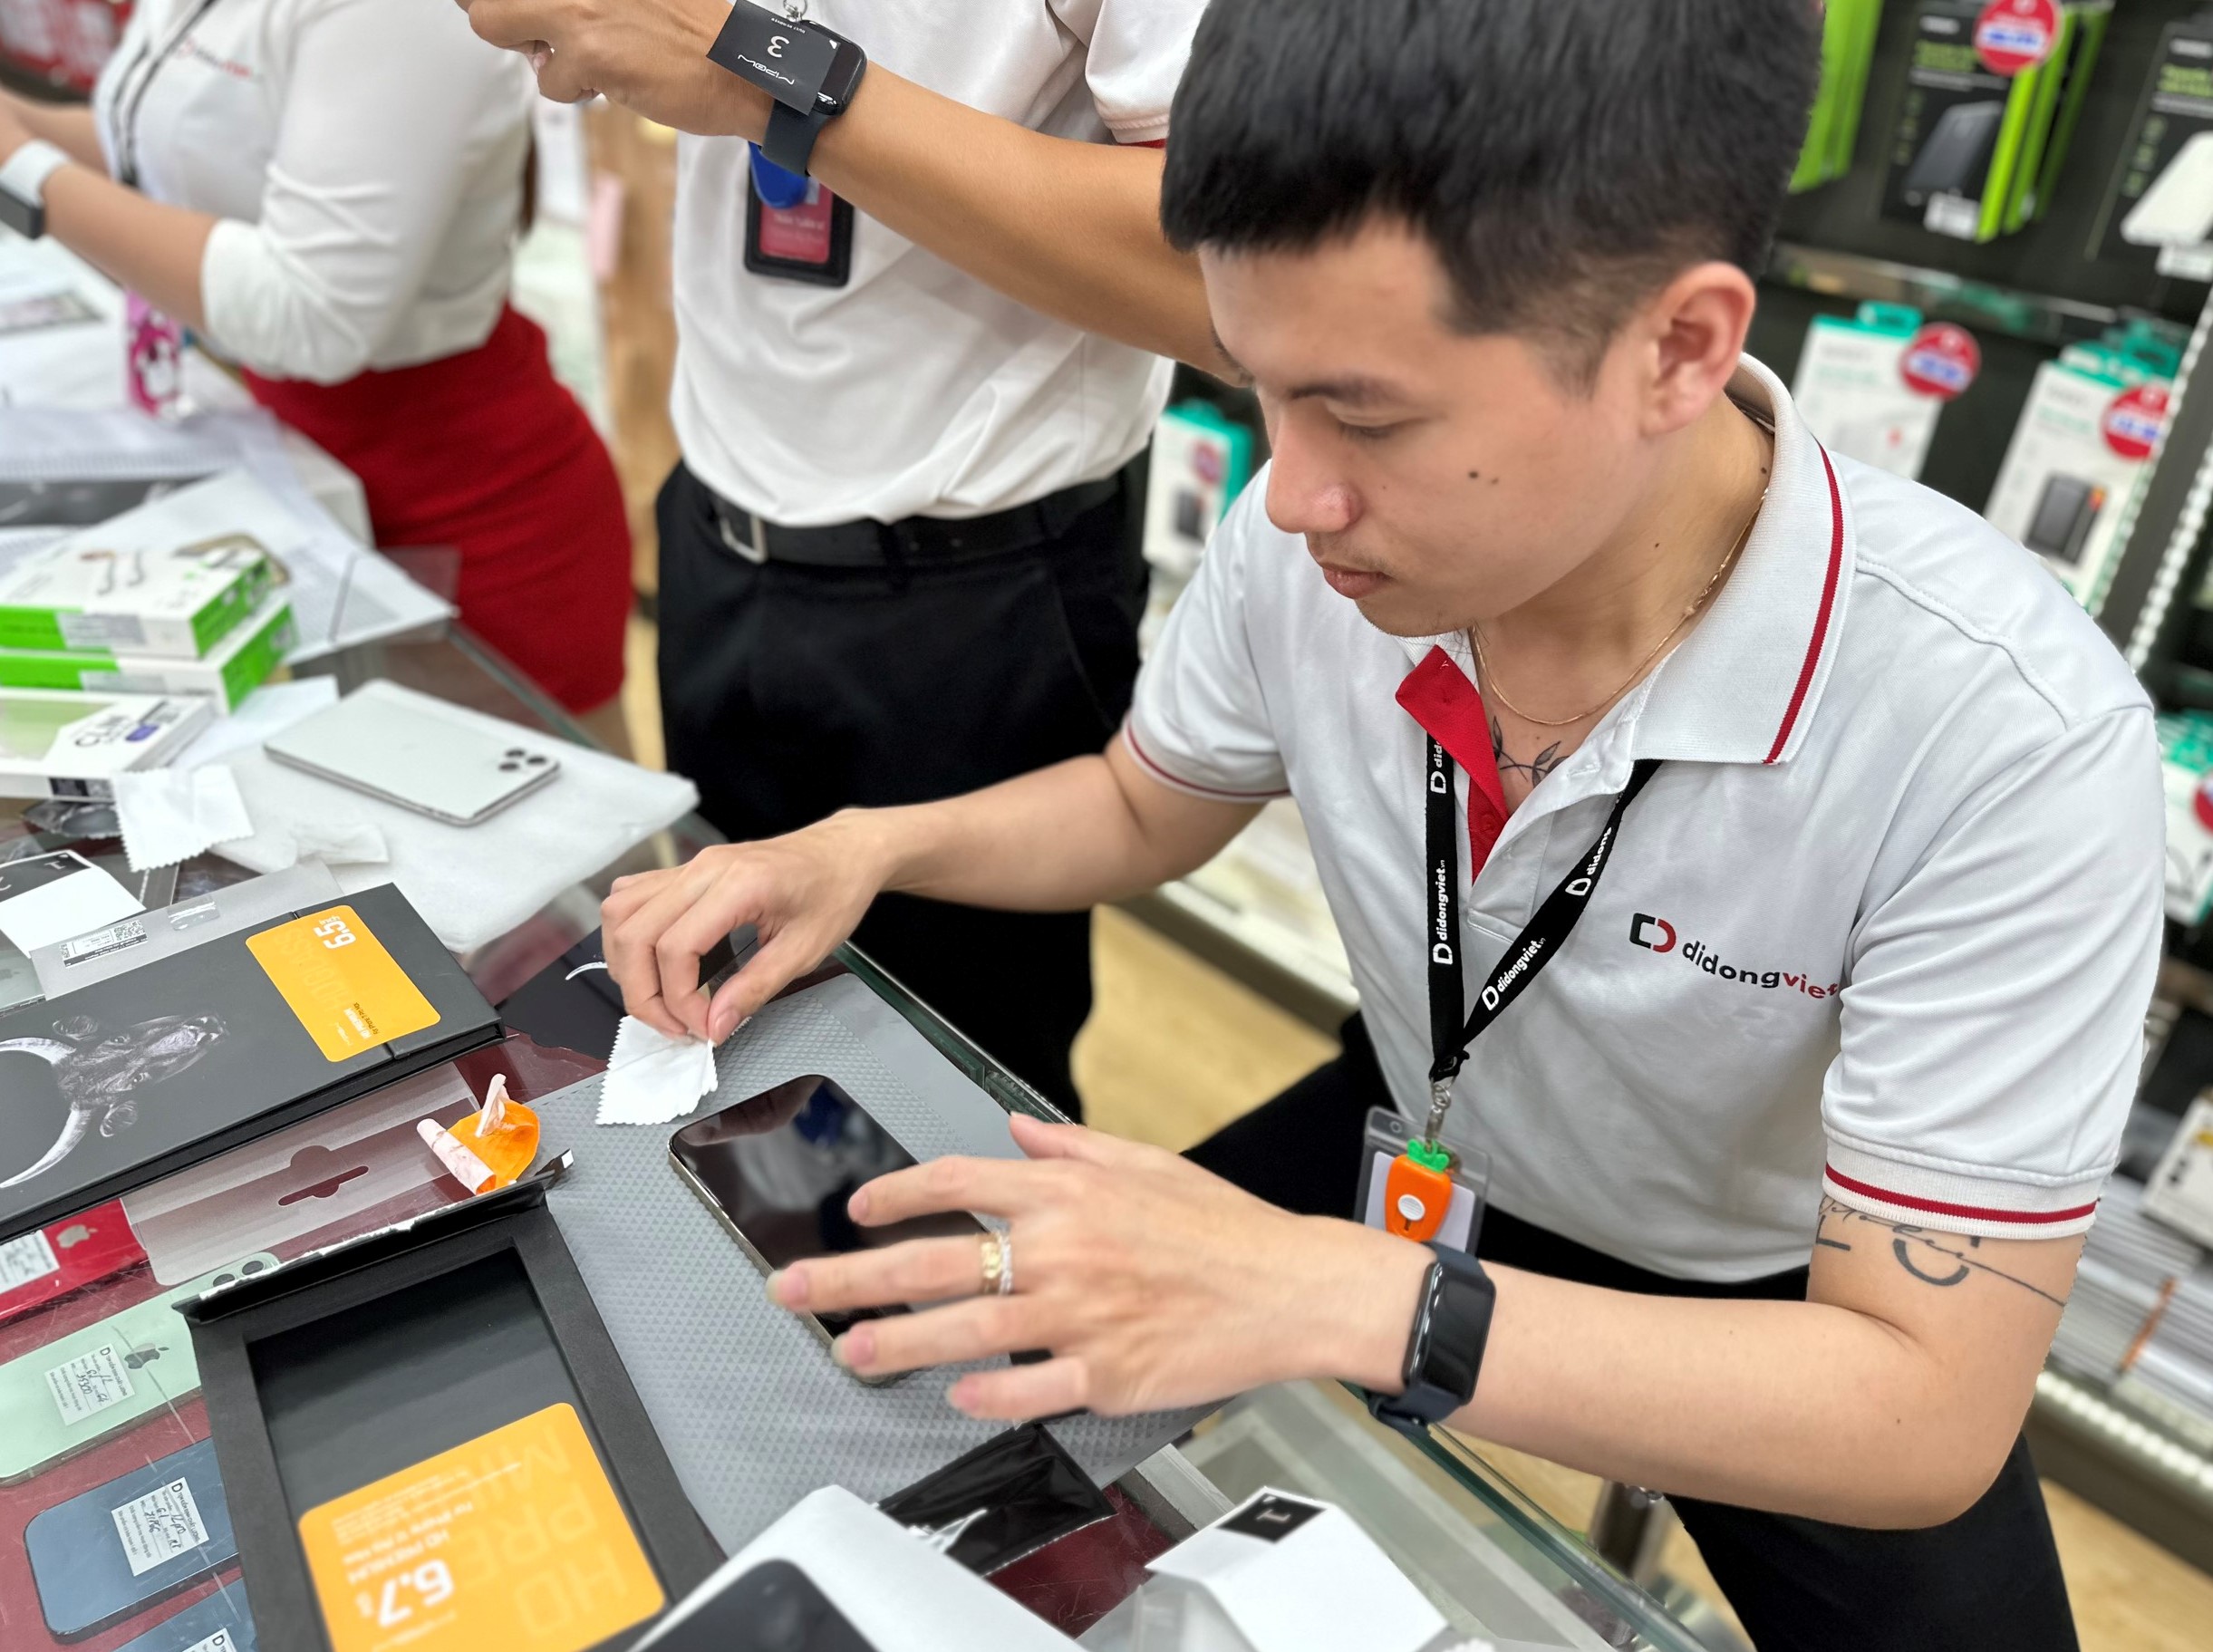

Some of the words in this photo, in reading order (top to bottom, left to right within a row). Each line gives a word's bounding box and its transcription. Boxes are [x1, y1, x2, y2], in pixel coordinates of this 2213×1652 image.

[767, 35, 790, 58] 3
[737, 54, 795, 85] MIPOW
[313, 918, 357, 949] 6.5
[378, 1558, 454, 1628] 6.7
